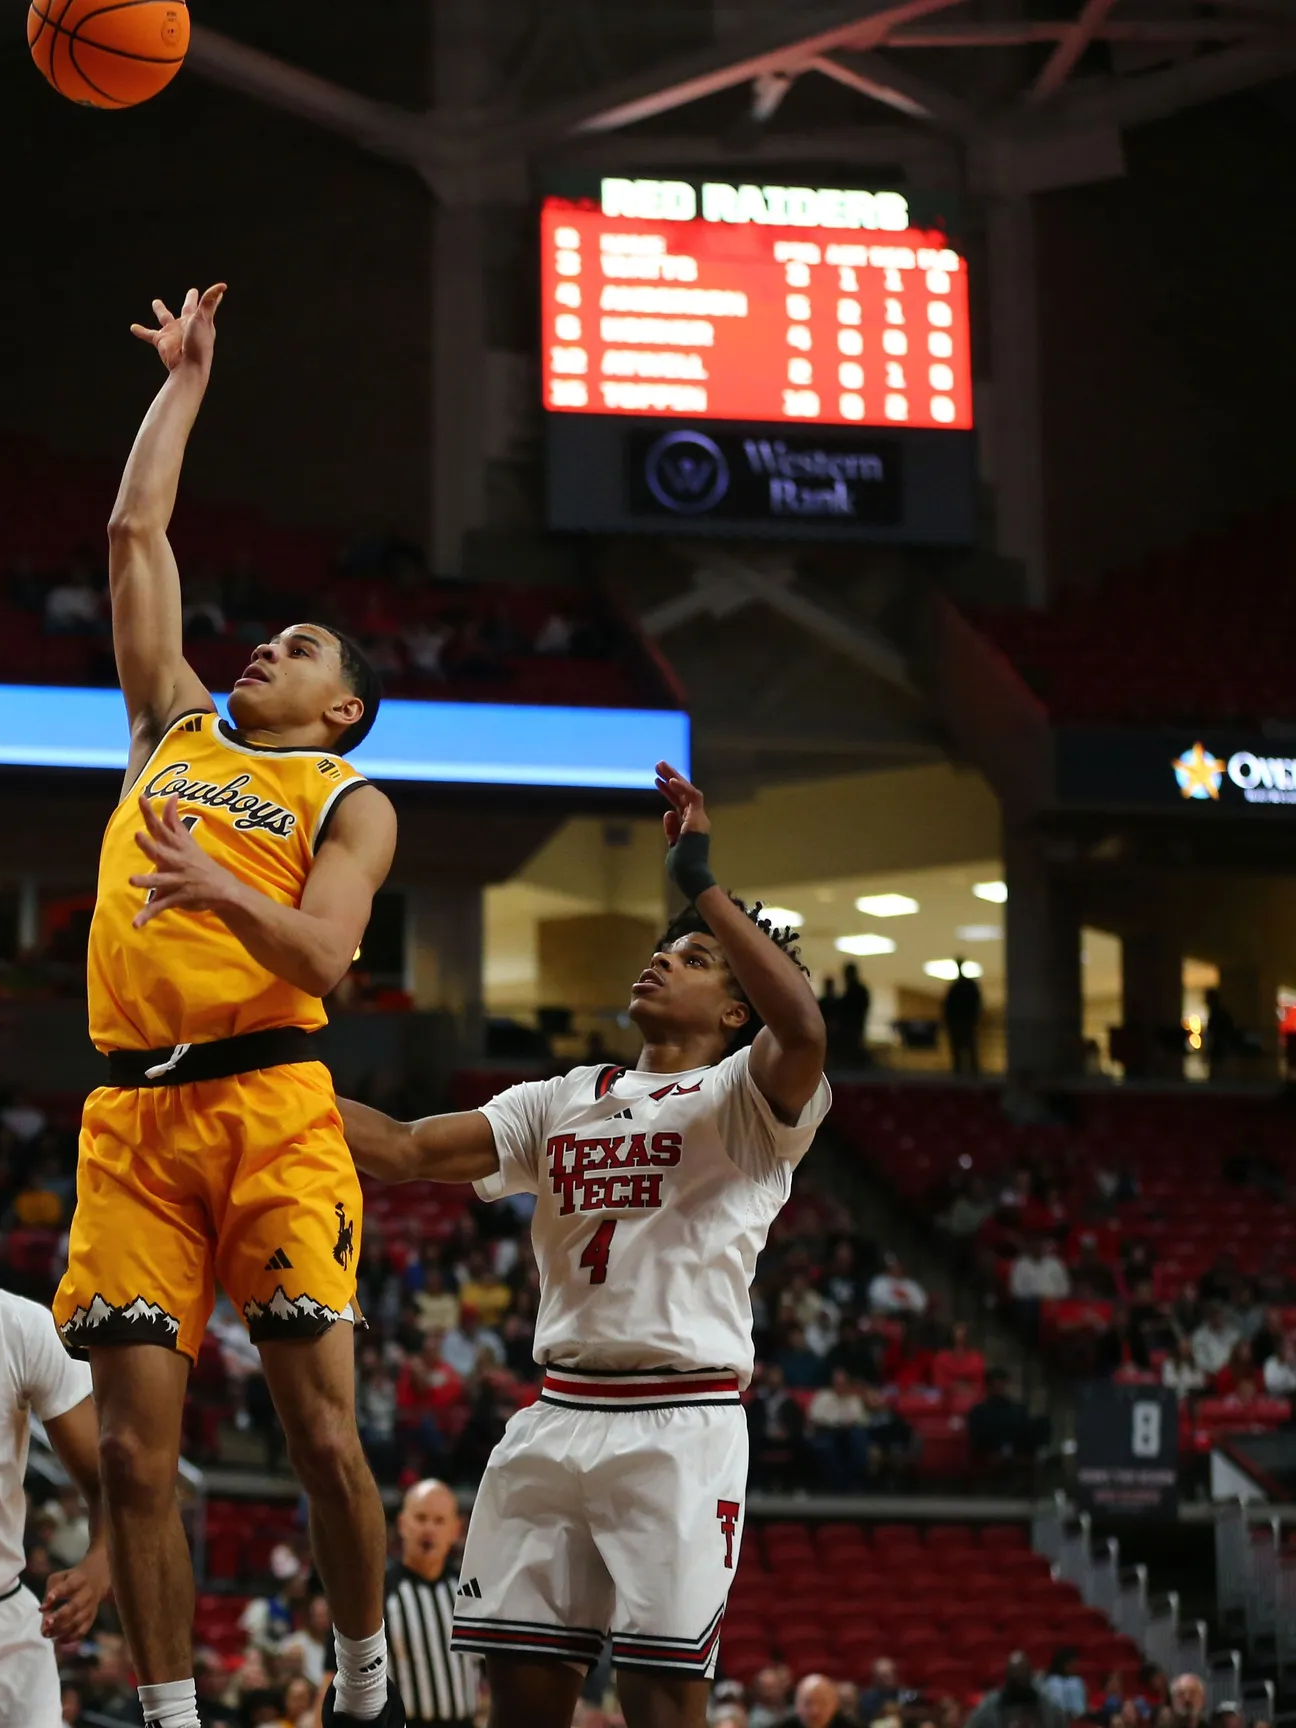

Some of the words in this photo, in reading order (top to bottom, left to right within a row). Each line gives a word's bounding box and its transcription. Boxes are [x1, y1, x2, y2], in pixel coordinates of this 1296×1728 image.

[601, 177, 697, 221] RED
[702, 182, 909, 231] RAIDERS
[743, 438, 884, 482] Western
[144, 763, 296, 838] Cowboys
[546, 1131, 683, 1178] TEXAS
[553, 1173, 664, 1217] TECH
[579, 1219, 618, 1285] 4
